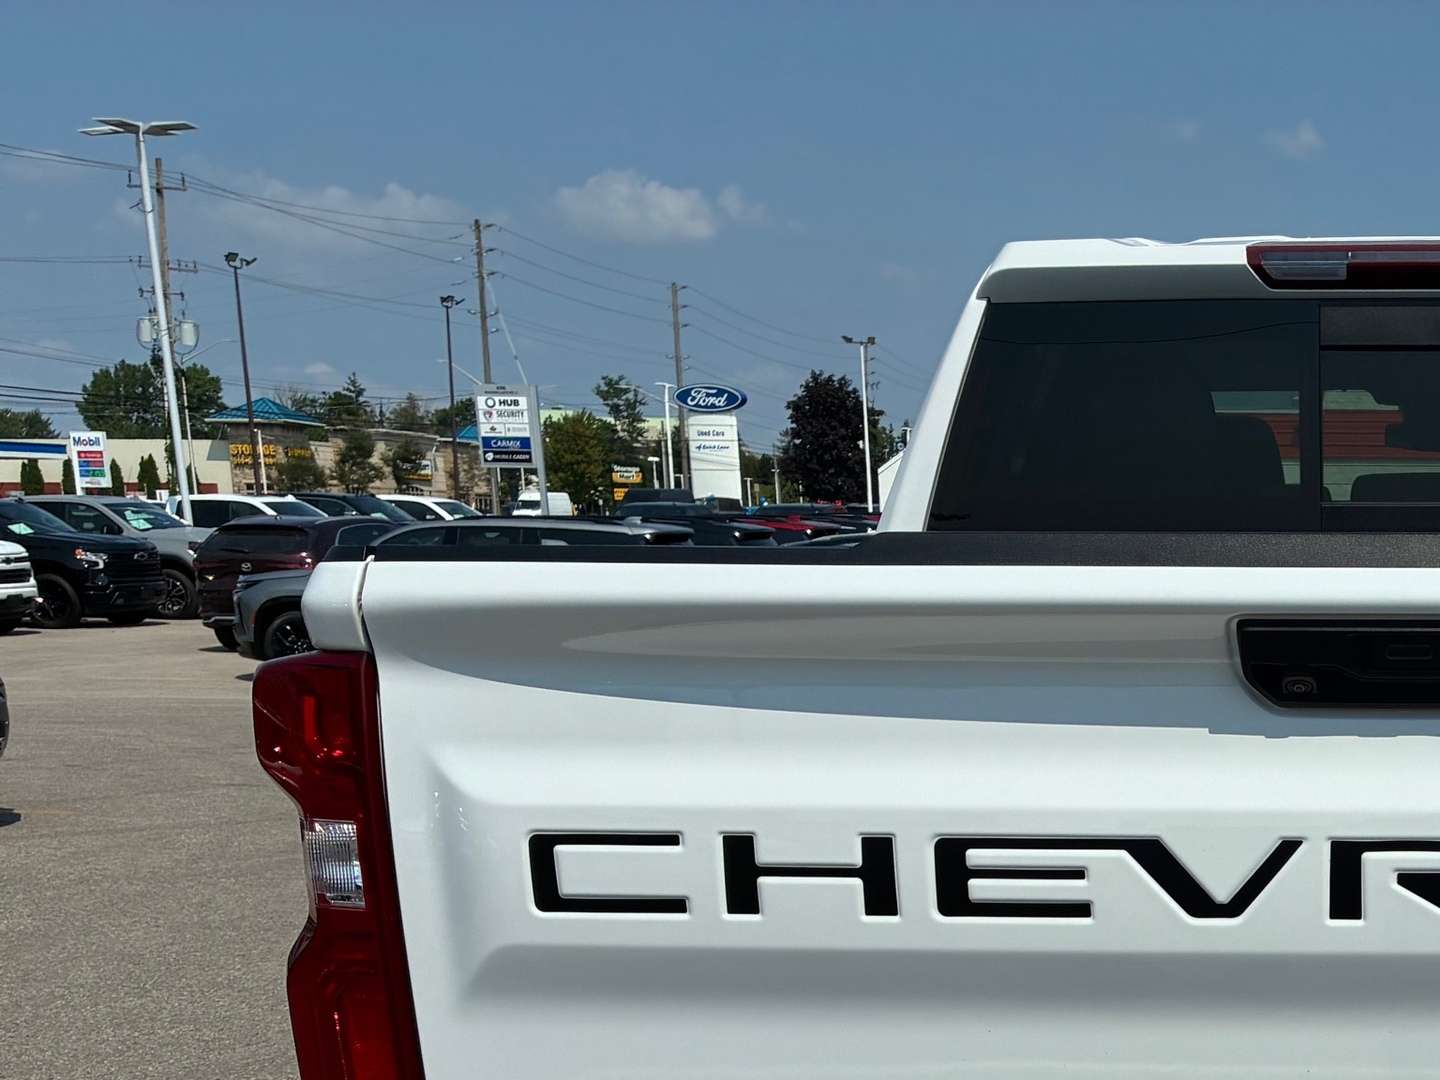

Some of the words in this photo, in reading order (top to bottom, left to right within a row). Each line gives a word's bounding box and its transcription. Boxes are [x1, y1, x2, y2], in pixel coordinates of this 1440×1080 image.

[687, 388, 728, 407] Ford
[498, 399, 520, 407] HUB
[496, 410, 524, 418] SECURITY
[72, 436, 101, 446] Mobil
[229, 443, 276, 456] STOGE
